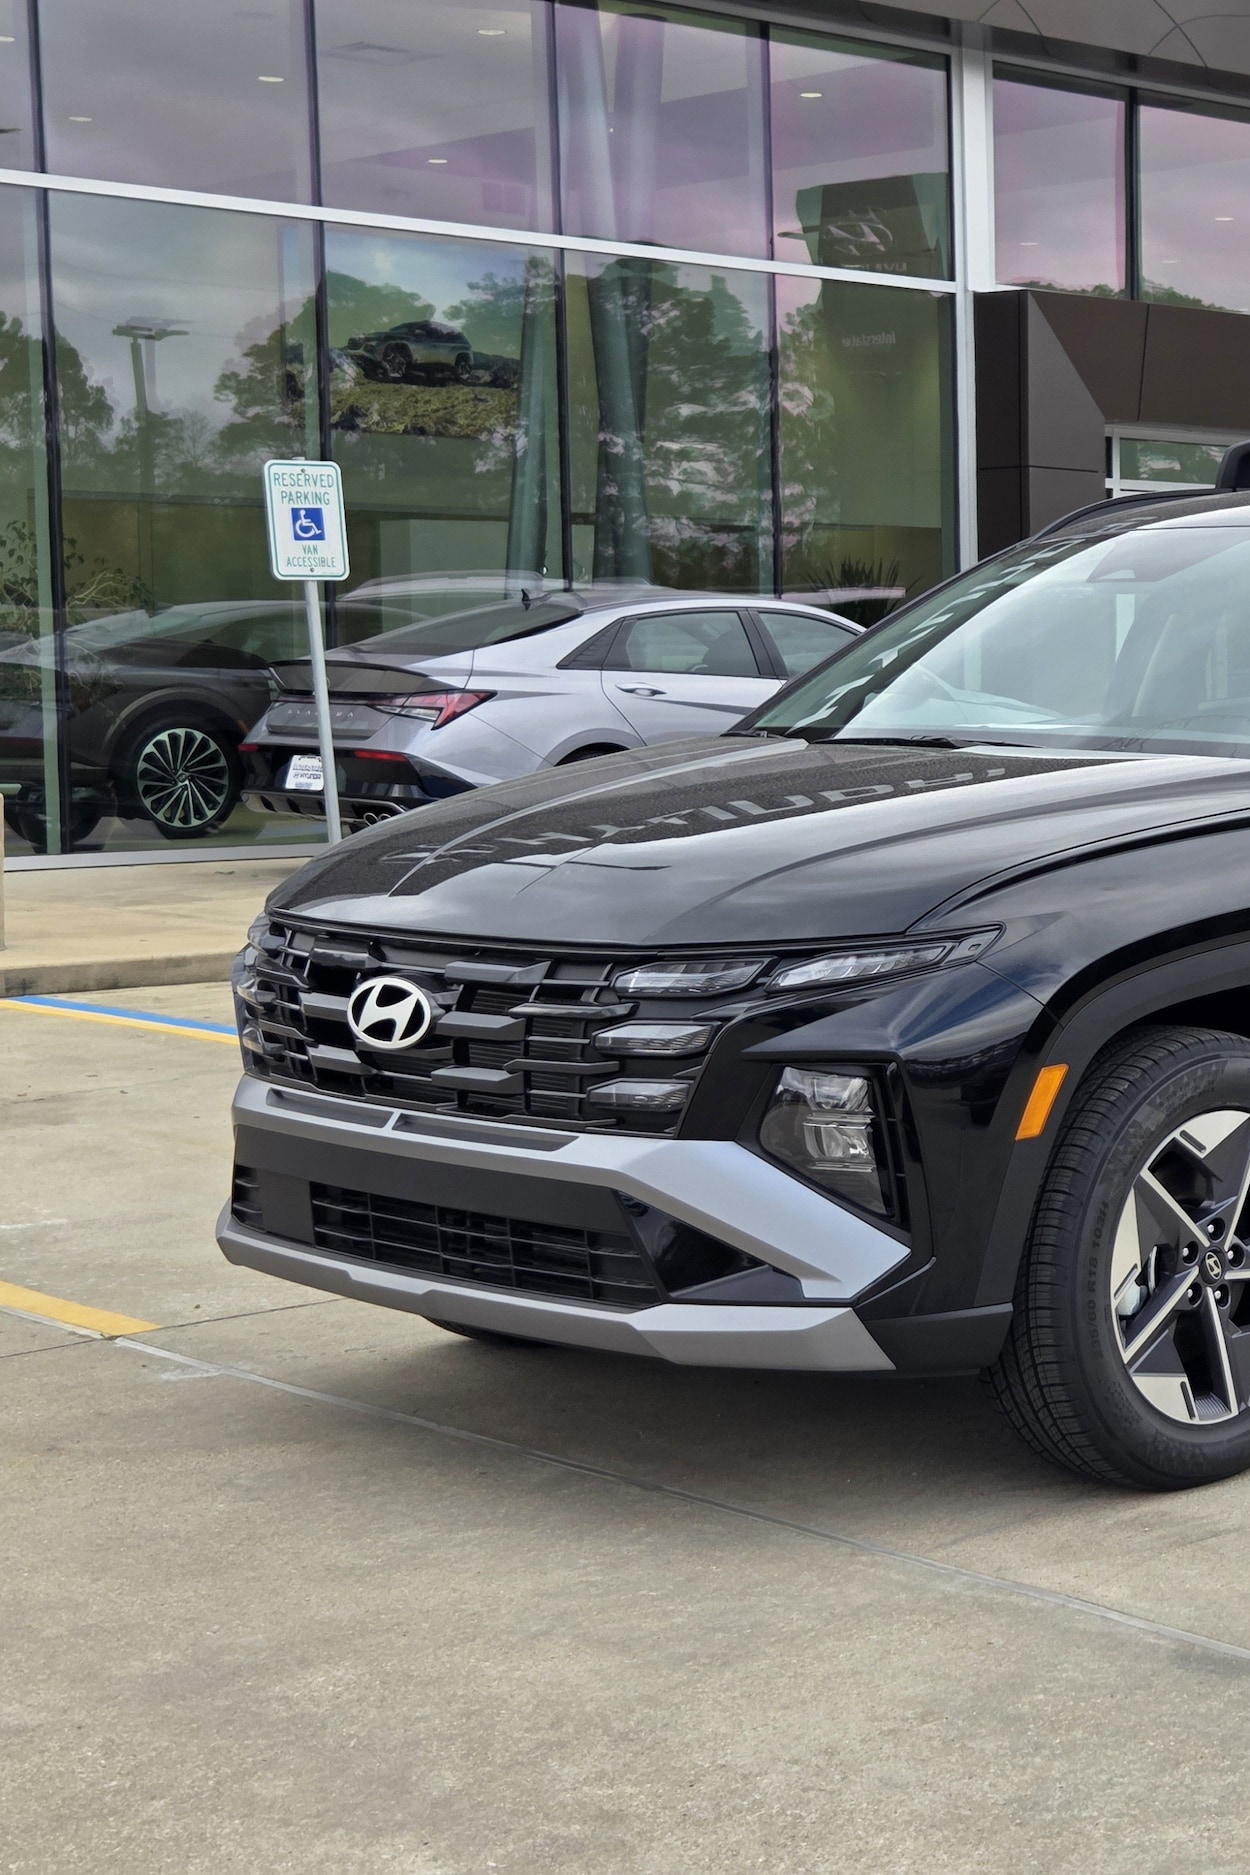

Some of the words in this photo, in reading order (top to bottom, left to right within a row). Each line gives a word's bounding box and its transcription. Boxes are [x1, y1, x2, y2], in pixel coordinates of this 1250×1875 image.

[273, 472, 334, 488] RESERVED
[280, 490, 330, 506] PARKING
[301, 544, 319, 555] VAN
[286, 556, 336, 568] ACCESSIBLE
[287, 708, 354, 718] ELARA
[1092, 1200, 1109, 1248] 103H
